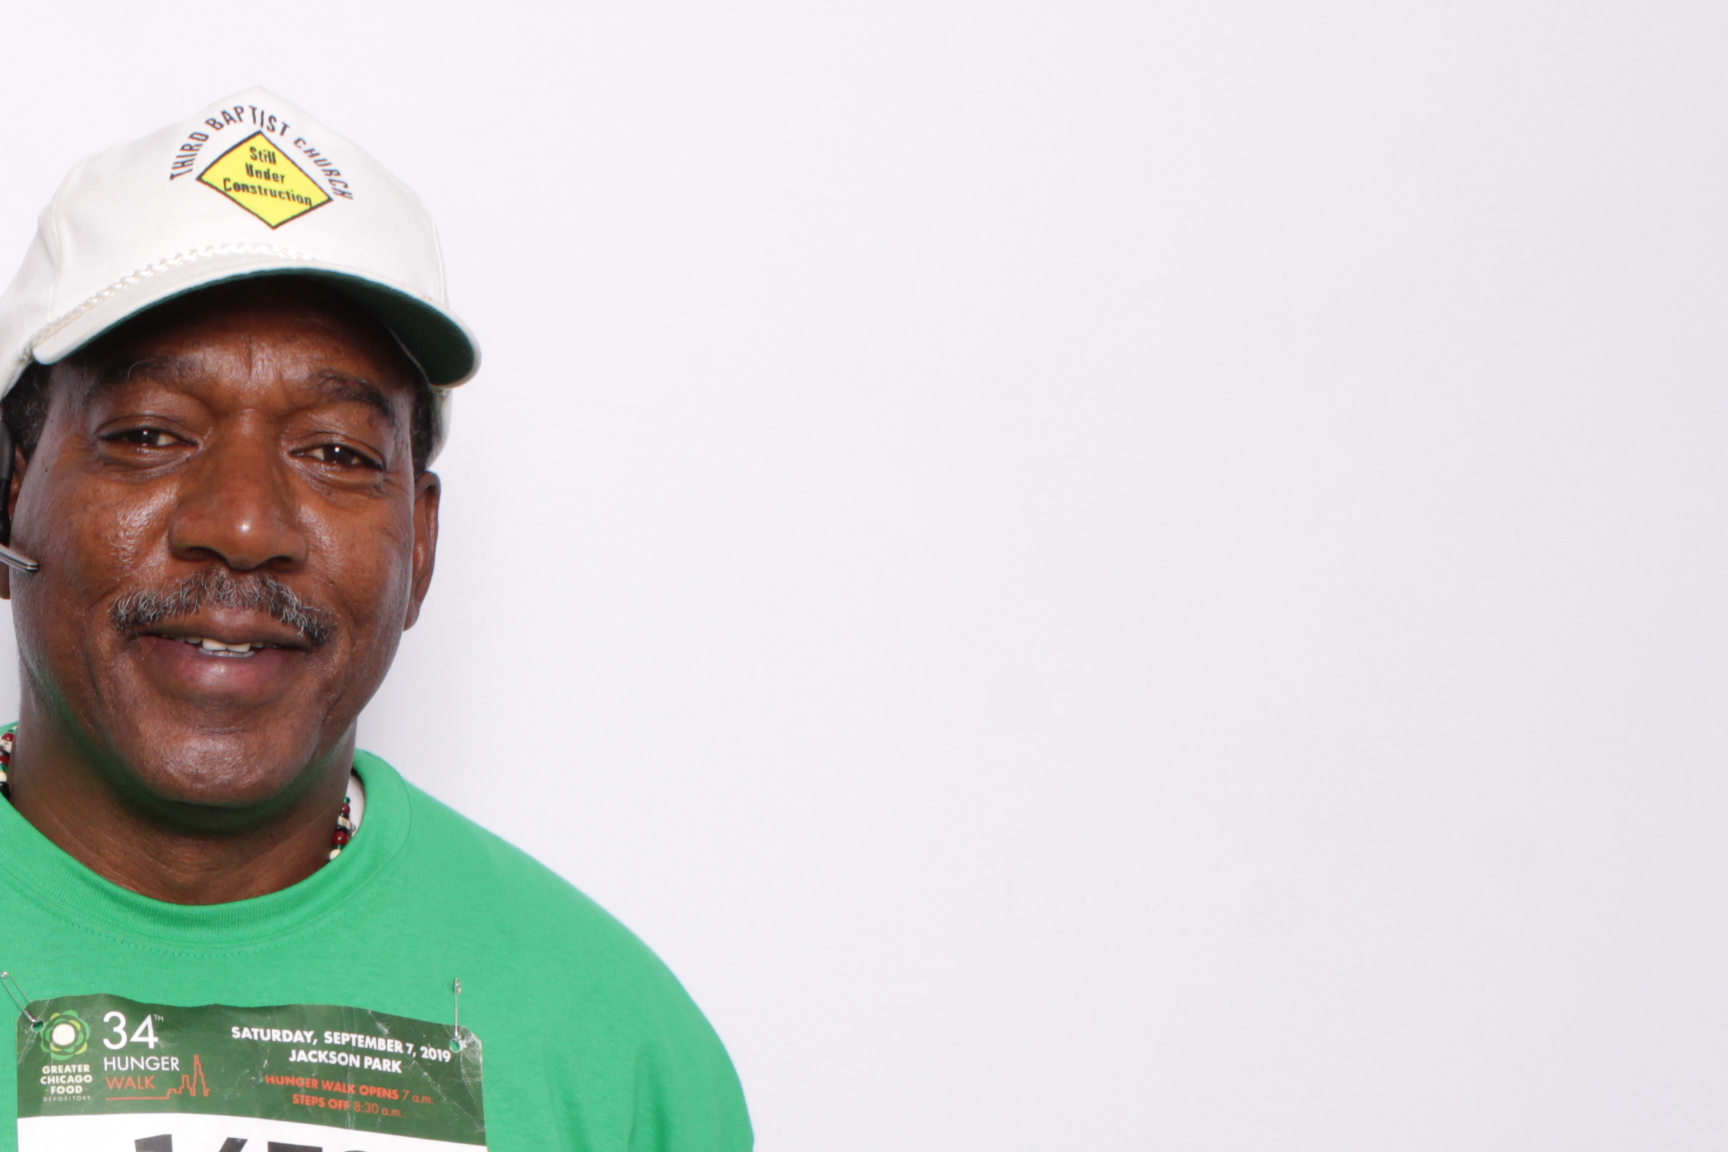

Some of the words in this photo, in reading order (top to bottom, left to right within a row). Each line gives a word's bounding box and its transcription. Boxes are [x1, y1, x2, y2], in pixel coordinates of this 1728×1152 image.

[170, 131, 209, 180] THIRD
[205, 105, 290, 136] BAPTIST
[293, 137, 353, 199] CHURCH
[249, 146, 276, 165] Still
[245, 163, 285, 183] Under
[223, 178, 312, 207] Construction
[231, 1026, 318, 1046] SATURDAY,
[324, 1031, 404, 1054] SEPTEMBER
[405, 1043, 417, 1058] 7,
[420, 1046, 451, 1063] 2019
[42, 1064, 90, 1074] GREATER
[103, 1056, 180, 1072] HUNGER
[289, 1049, 360, 1068] JACKSON
[364, 1057, 402, 1074] PARK
[40, 1075, 93, 1085] CHICAGO
[105, 1075, 156, 1090] WALK
[265, 1074, 319, 1090] HUNGER
[322, 1080, 356, 1094] WALK
[359, 1085, 399, 1100] OPENS
[402, 1090, 410, 1100] 7
[412, 1093, 434, 1105] a.m.
[292, 1093, 325, 1108] STEPS
[328, 1098, 351, 1111] OFF
[353, 1101, 380, 1115] 8:30
[381, 1106, 403, 1118] a.m.
